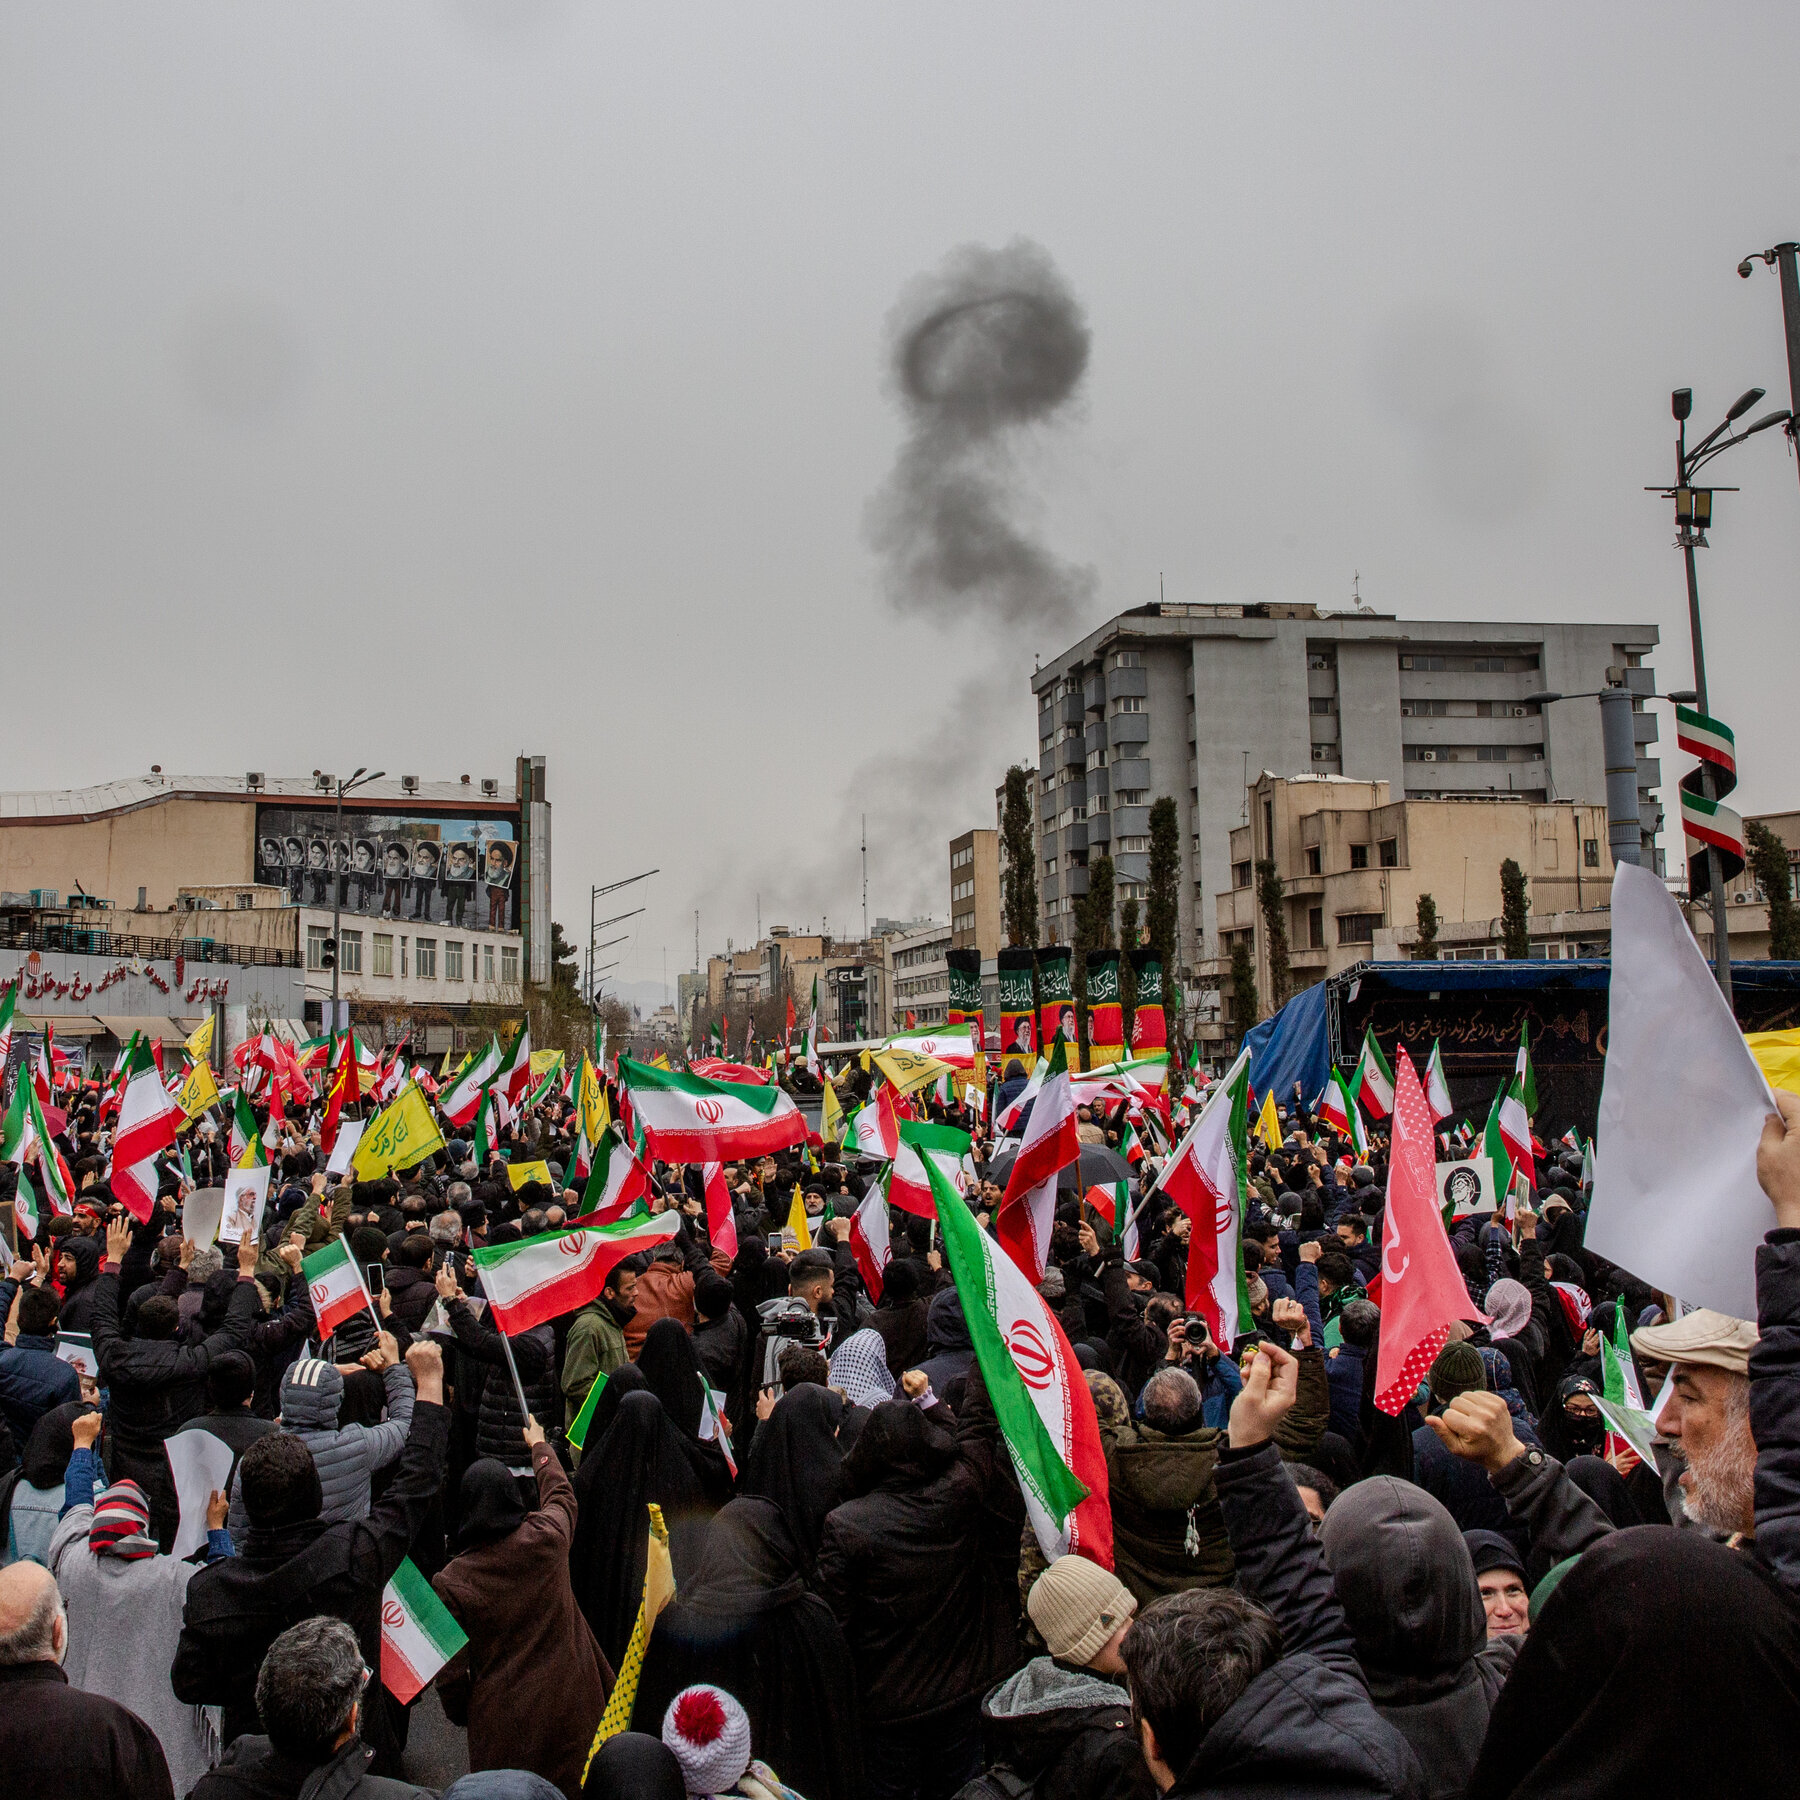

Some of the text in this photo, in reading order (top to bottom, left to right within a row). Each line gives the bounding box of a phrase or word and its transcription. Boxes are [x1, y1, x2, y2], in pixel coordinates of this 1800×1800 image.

[26, 970, 93, 1000] مرغ سوخاری
[185, 977, 209, 1003] ترکی
